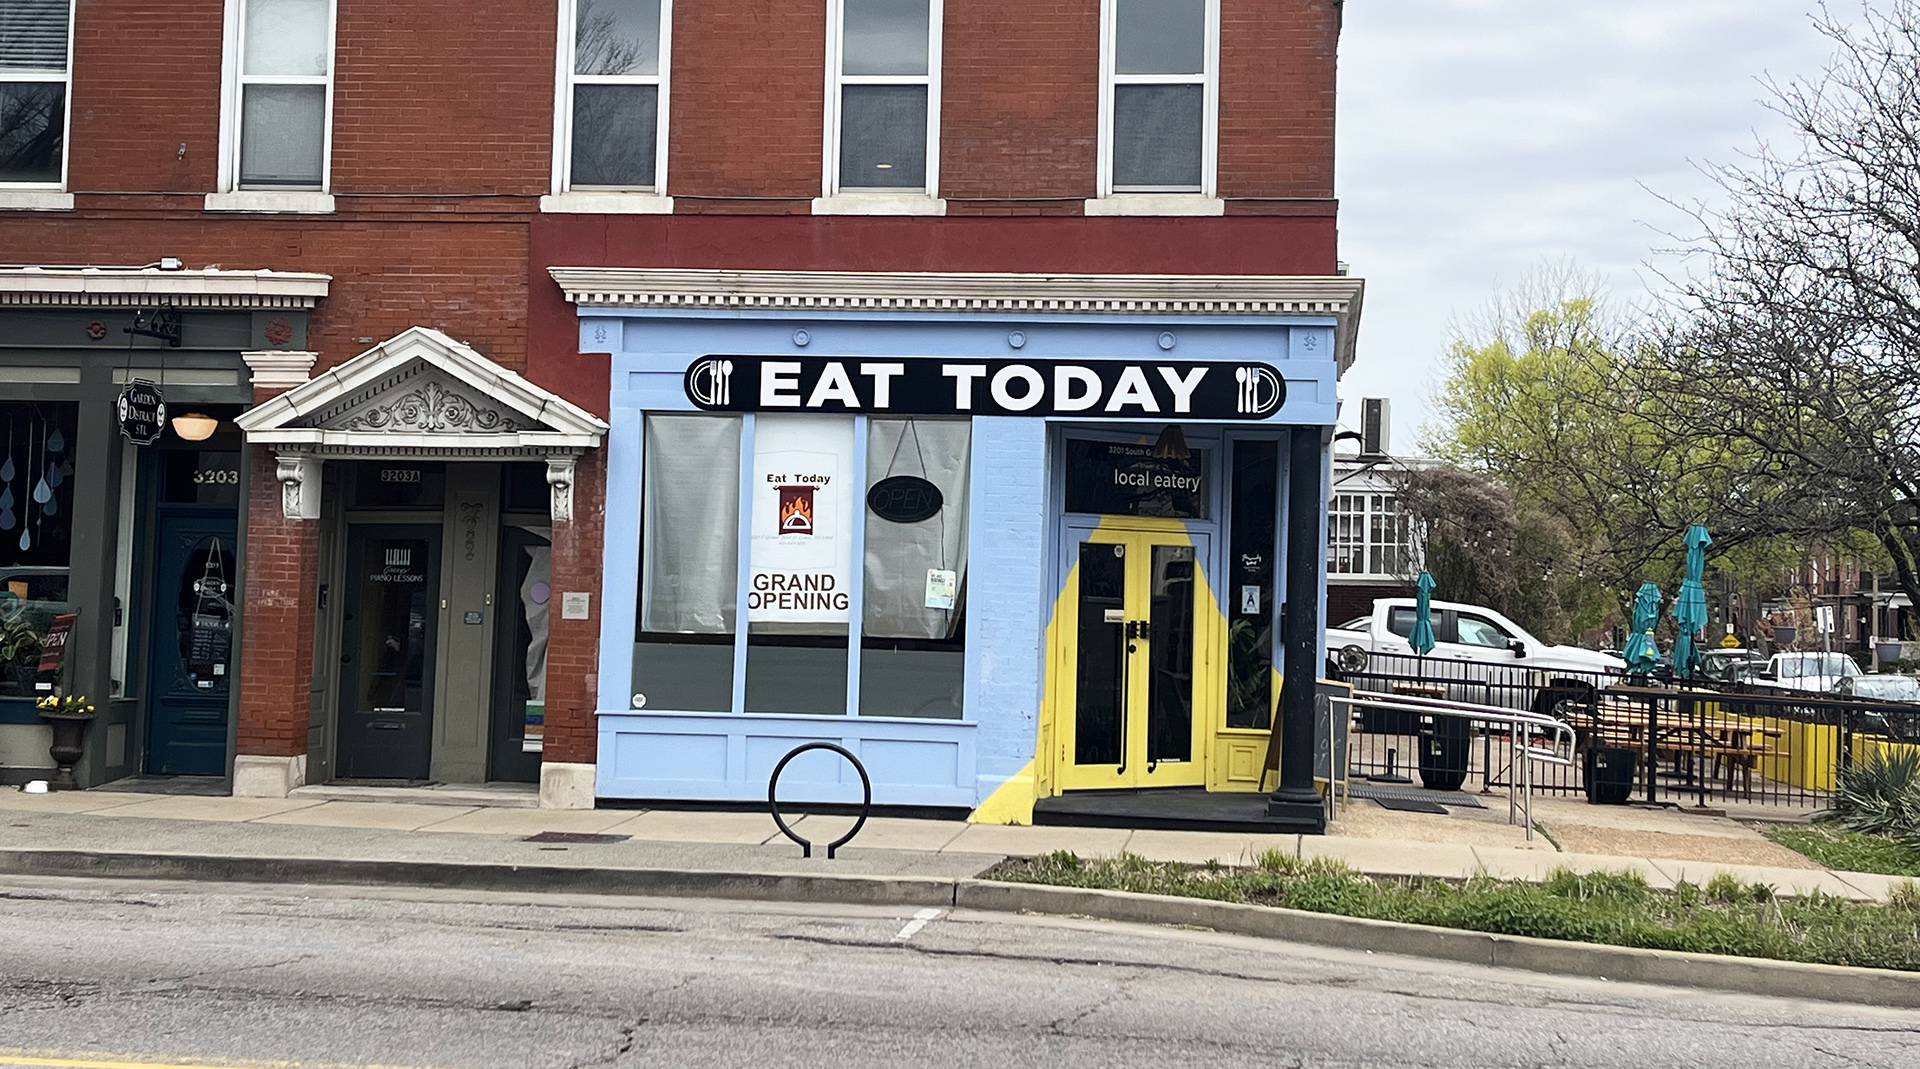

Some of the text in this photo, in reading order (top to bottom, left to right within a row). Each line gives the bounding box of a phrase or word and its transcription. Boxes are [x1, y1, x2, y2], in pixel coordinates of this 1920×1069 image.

[760, 362, 1210, 413] EAT TODAY
[135, 424, 147, 435] STL
[1108, 446, 1124, 454] 3201
[1125, 447, 1144, 456] South
[193, 470, 238, 484] 3203
[382, 470, 420, 481] 3203A
[767, 474, 831, 485] Eat Today
[1114, 468, 1200, 492] local eatery
[873, 487, 934, 511] OPEN
[370, 574, 424, 582] PIANO LESSONS
[753, 573, 836, 591] GRAND
[748, 591, 849, 610] OPENING
[1247, 593, 1255, 605] A
[46, 631, 68, 648] PEN
